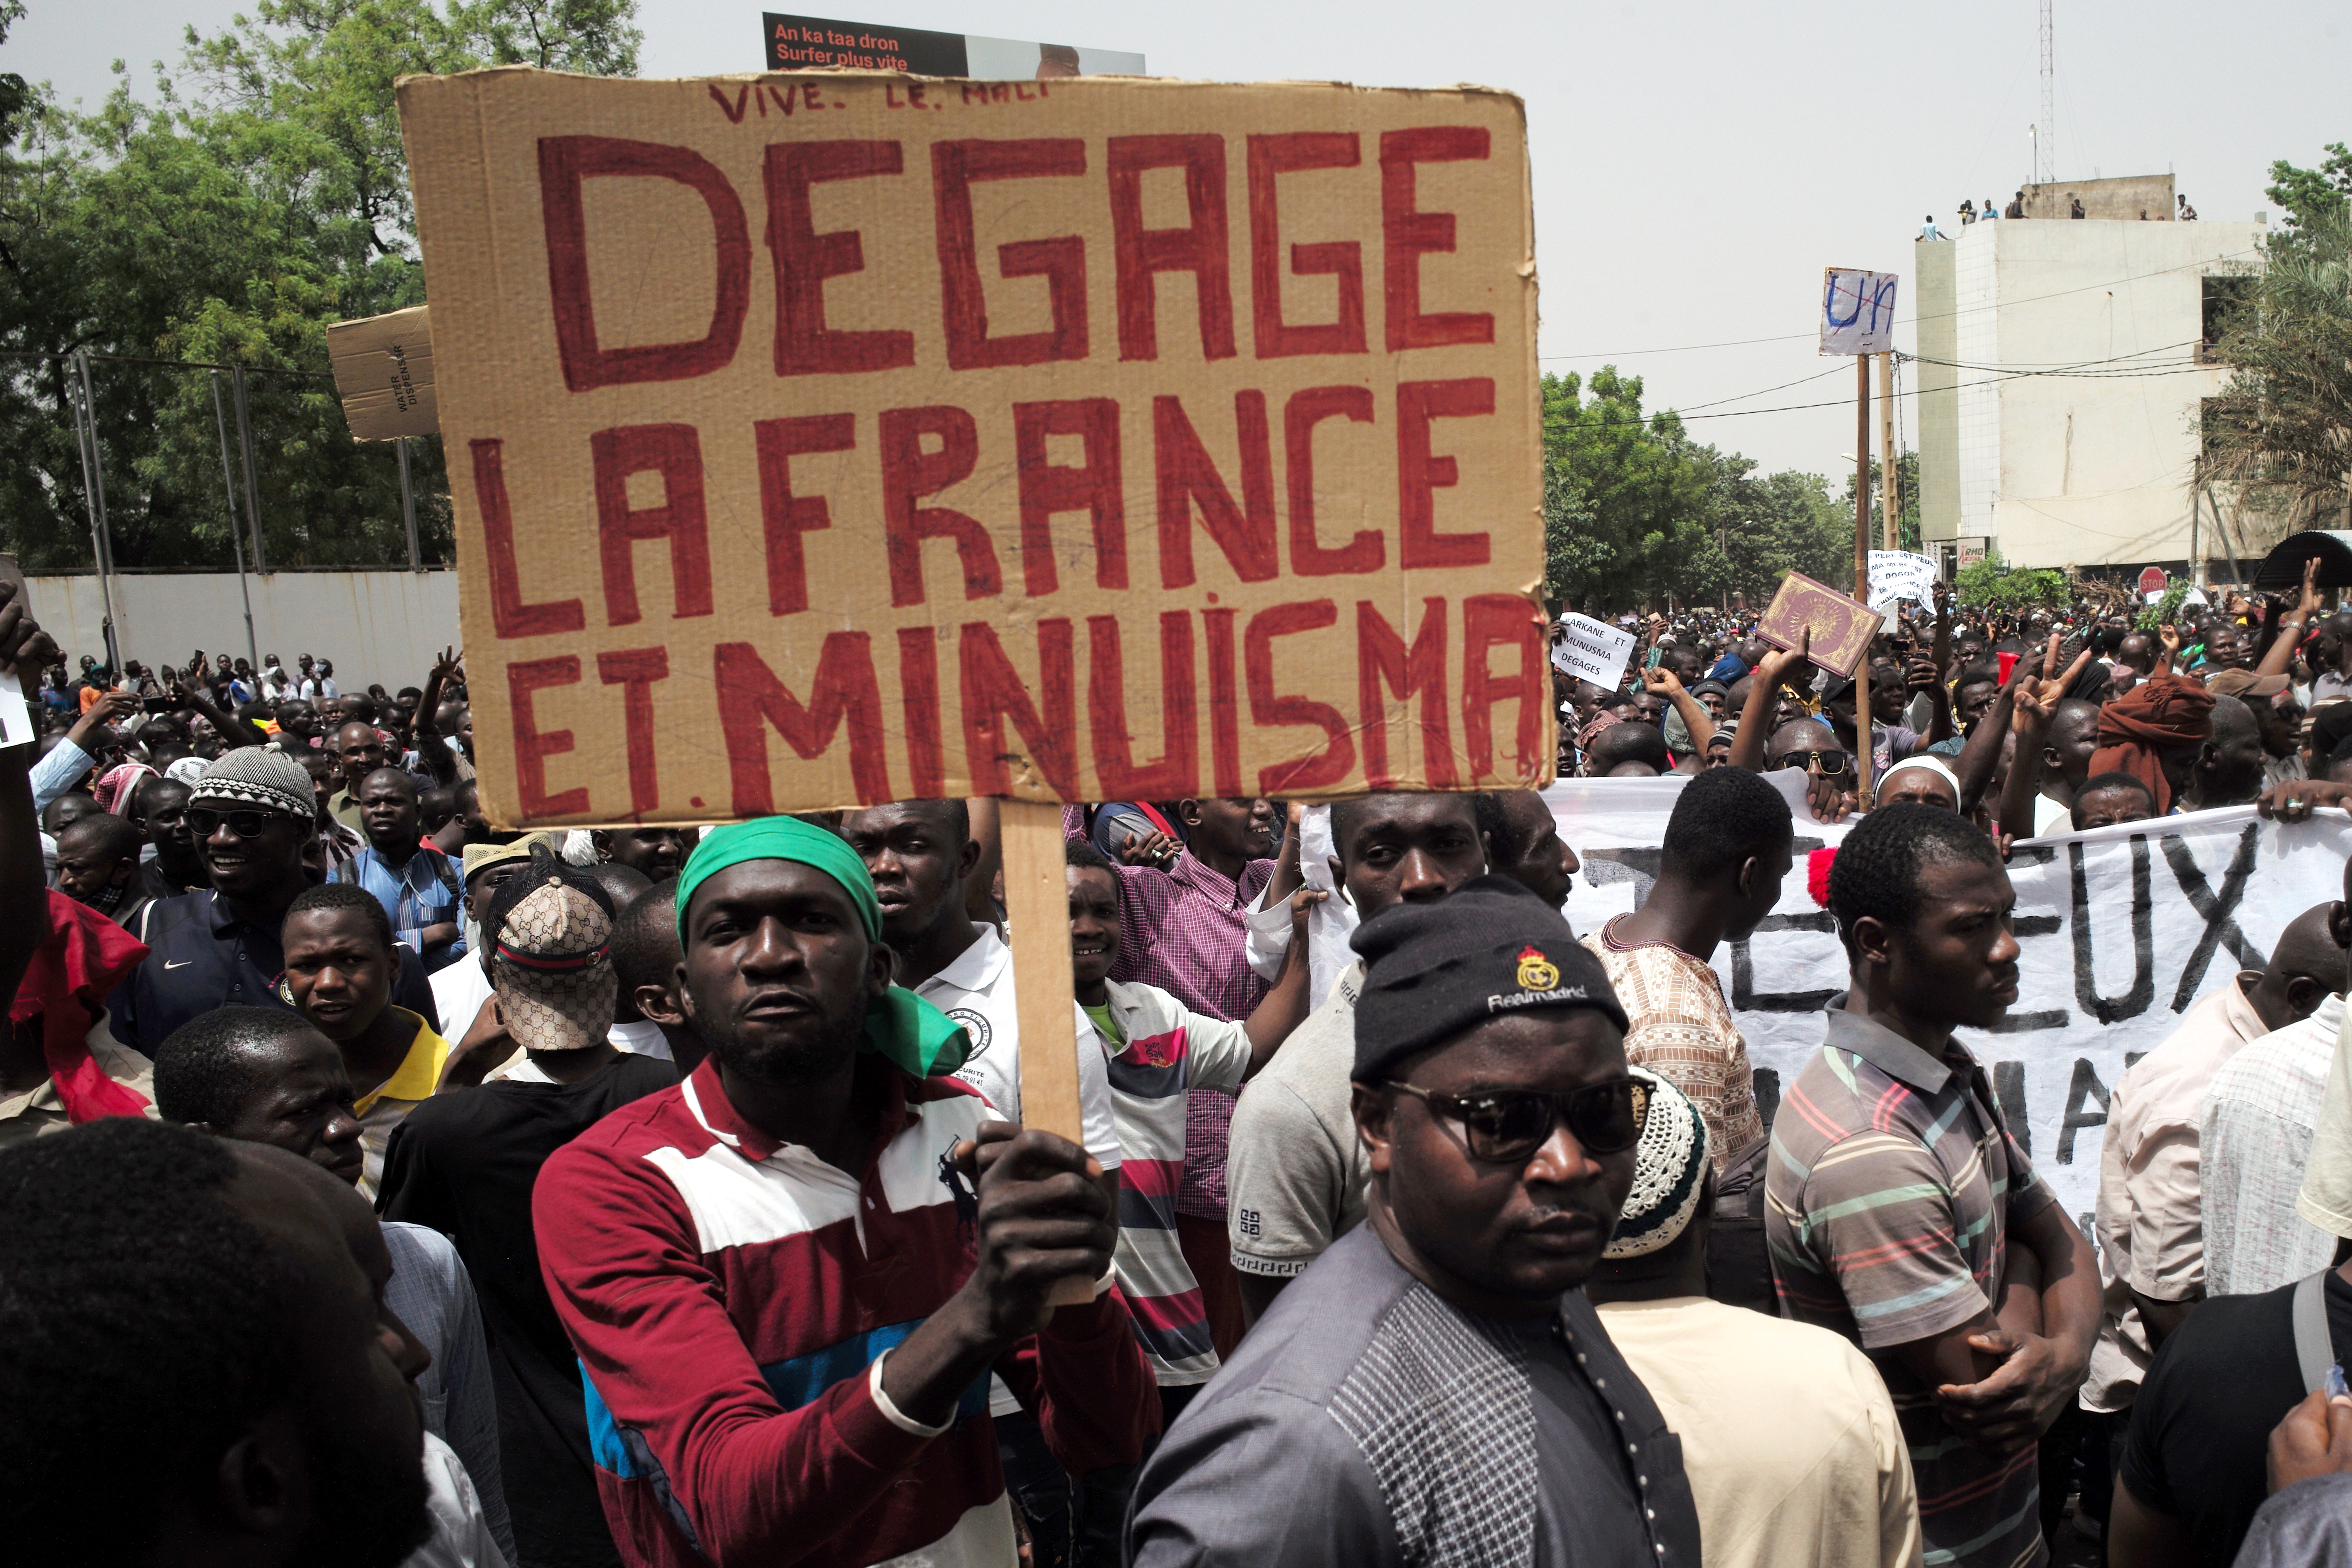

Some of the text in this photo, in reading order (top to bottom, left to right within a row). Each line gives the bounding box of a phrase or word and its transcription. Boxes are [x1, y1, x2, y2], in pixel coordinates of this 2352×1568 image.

[775, 24, 898, 51] An ka taa dron
[777, 43, 907, 71] Surfer plus vite
[962, 80, 1048, 105] MALI
[537, 126, 1496, 392] DEGAGE
[394, 345, 417, 405] DISPENSER
[392, 376, 407, 412] WATER
[469, 377, 1496, 639] LA FRANCE
[1965, 548, 1983, 556] RMO
[2142, 579, 2164, 589] STOP
[1564, 635, 1611, 661] MUNUSMA
[1615, 637, 1626, 646] ET
[1561, 653, 1601, 675] DEGAGES
[970, 1013, 988, 1047] SECURITE
[959, 1067, 985, 1078] CURITE
